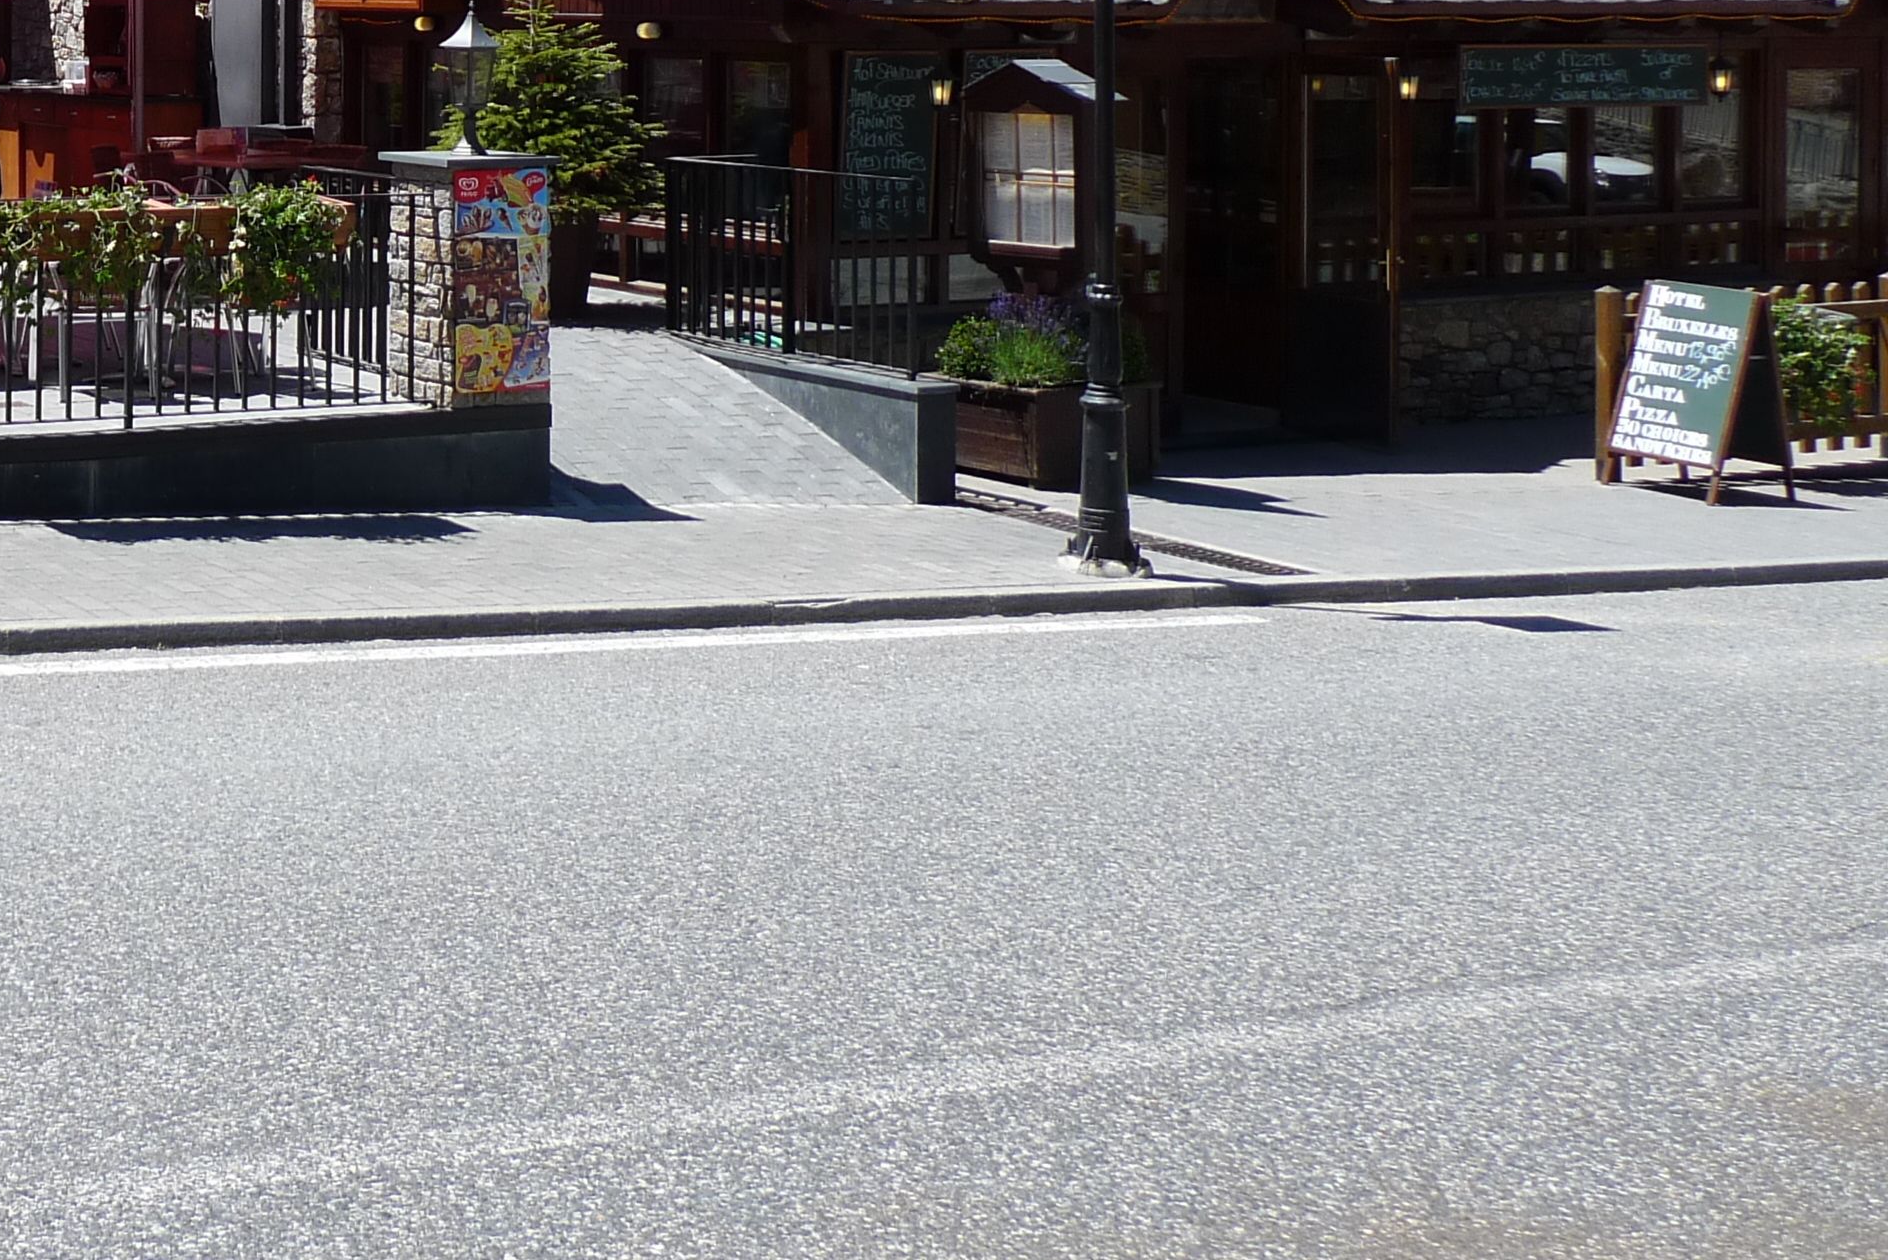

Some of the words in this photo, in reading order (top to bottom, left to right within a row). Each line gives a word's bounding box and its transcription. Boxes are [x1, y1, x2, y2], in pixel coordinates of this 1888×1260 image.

[1648, 284, 1706, 310] HOTEL
[1642, 307, 1739, 341] BRUXELLES
[1635, 329, 1688, 357] MENU
[1630, 351, 1682, 379] MENU
[1627, 375, 1686, 403] CARTA
[1619, 396, 1678, 426] PIZZA
